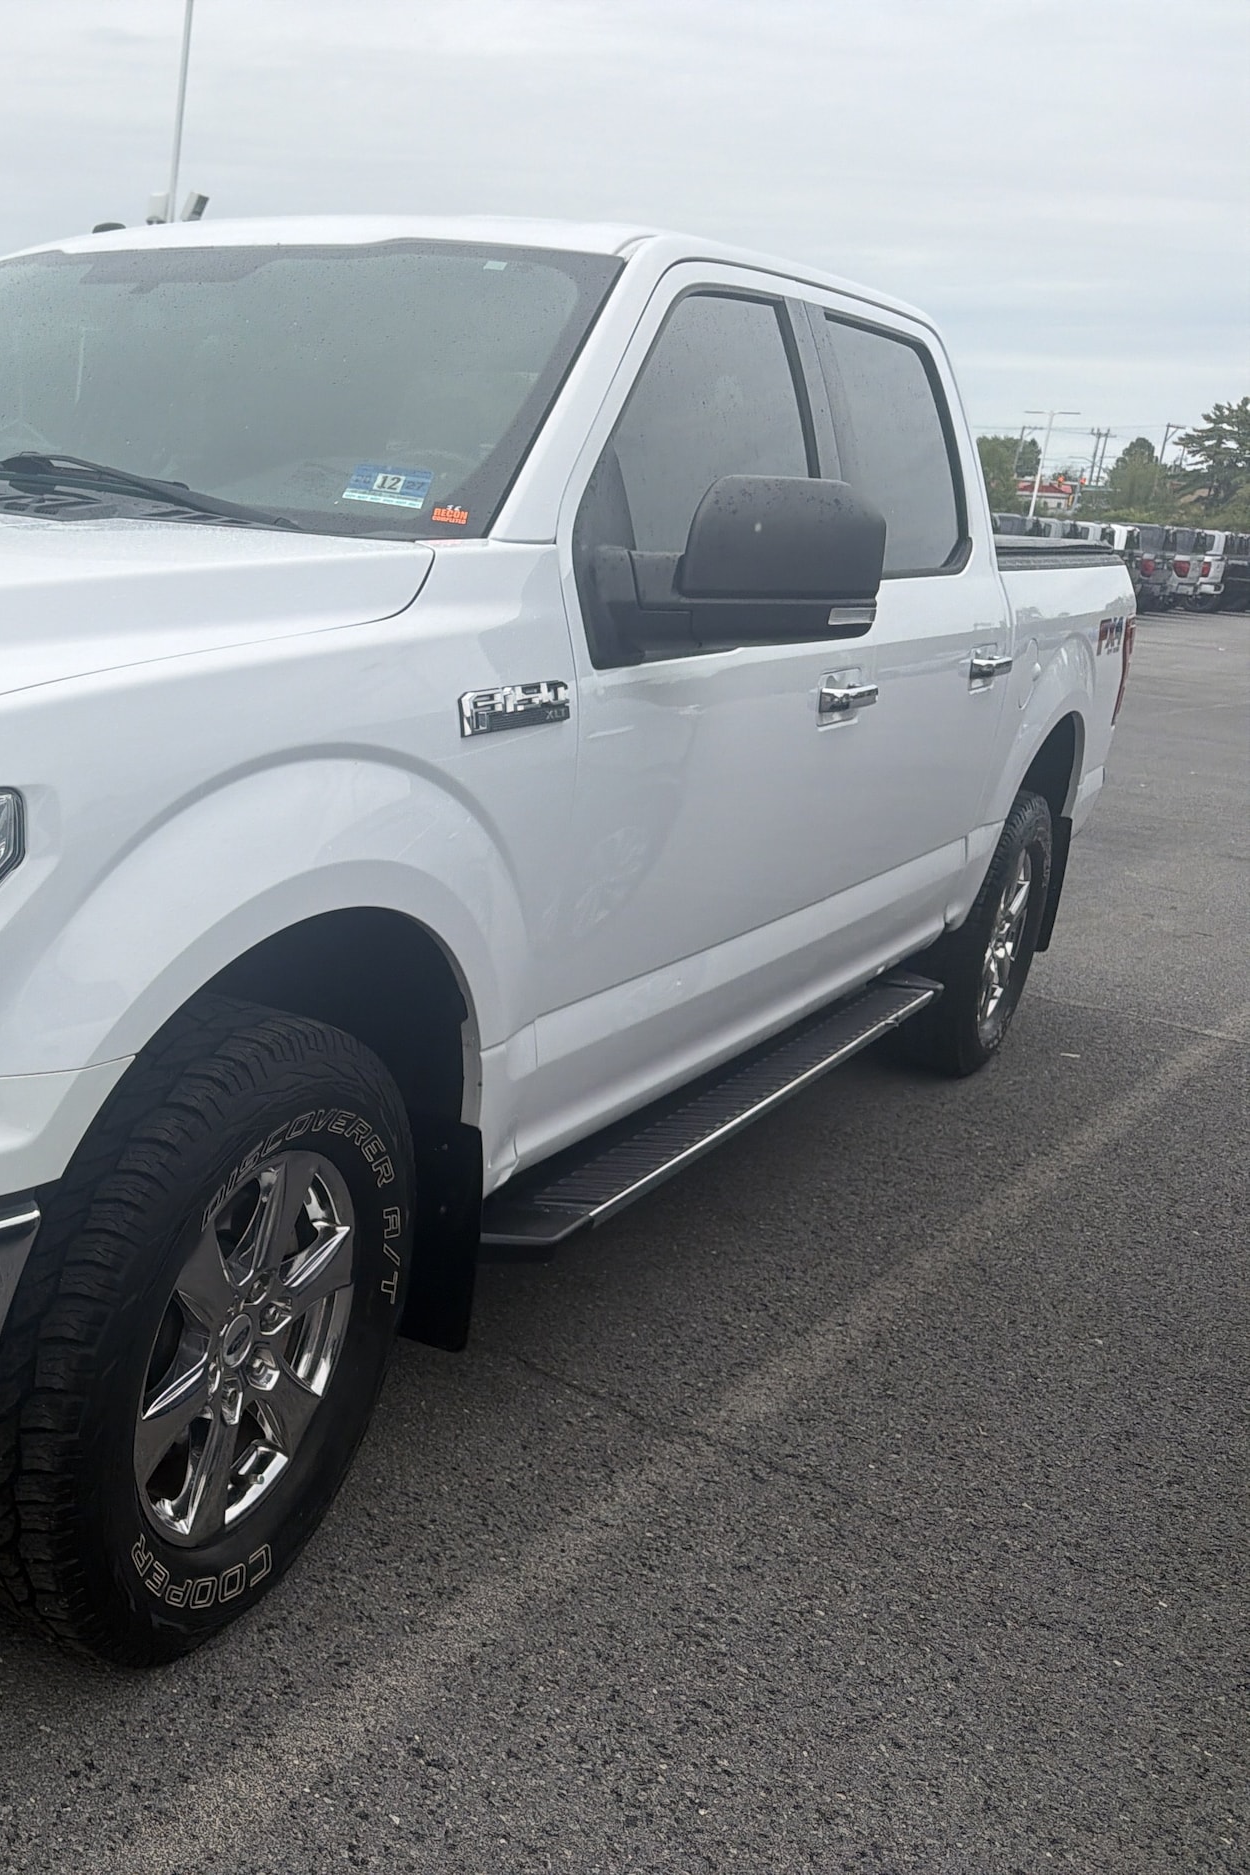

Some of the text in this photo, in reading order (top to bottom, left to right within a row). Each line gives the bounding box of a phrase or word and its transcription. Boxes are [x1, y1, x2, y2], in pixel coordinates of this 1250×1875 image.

[377, 475, 401, 491] 12
[433, 507, 469, 520] RECON
[458, 680, 569, 737] F-150
[545, 708, 566, 720] XLT
[201, 1108, 402, 1305] DISCOVERER A/T
[130, 1532, 273, 1610] COOPER
